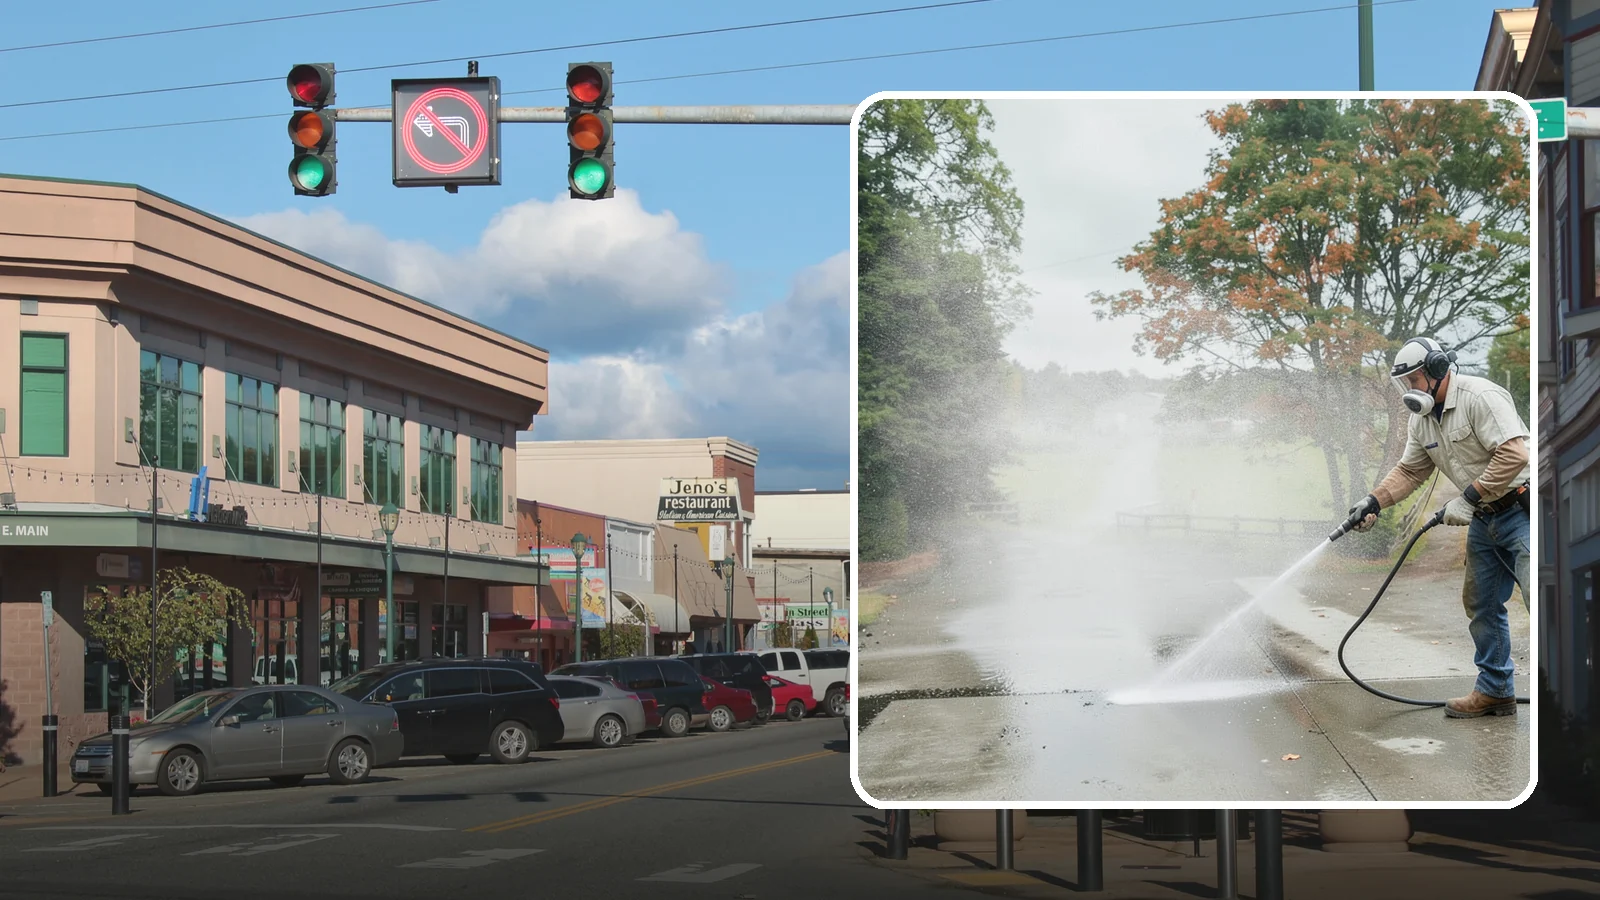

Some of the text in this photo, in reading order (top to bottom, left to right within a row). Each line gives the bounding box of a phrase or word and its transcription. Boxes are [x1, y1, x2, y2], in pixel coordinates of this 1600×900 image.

[669, 480, 728, 495] Jeno's
[665, 496, 731, 509] restaurant
[685, 509, 715, 519] American
[714, 509, 738, 519] Cuisine
[2, 525, 49, 536] E. MAIN
[797, 607, 828, 617] Street
[790, 619, 823, 627] lass
